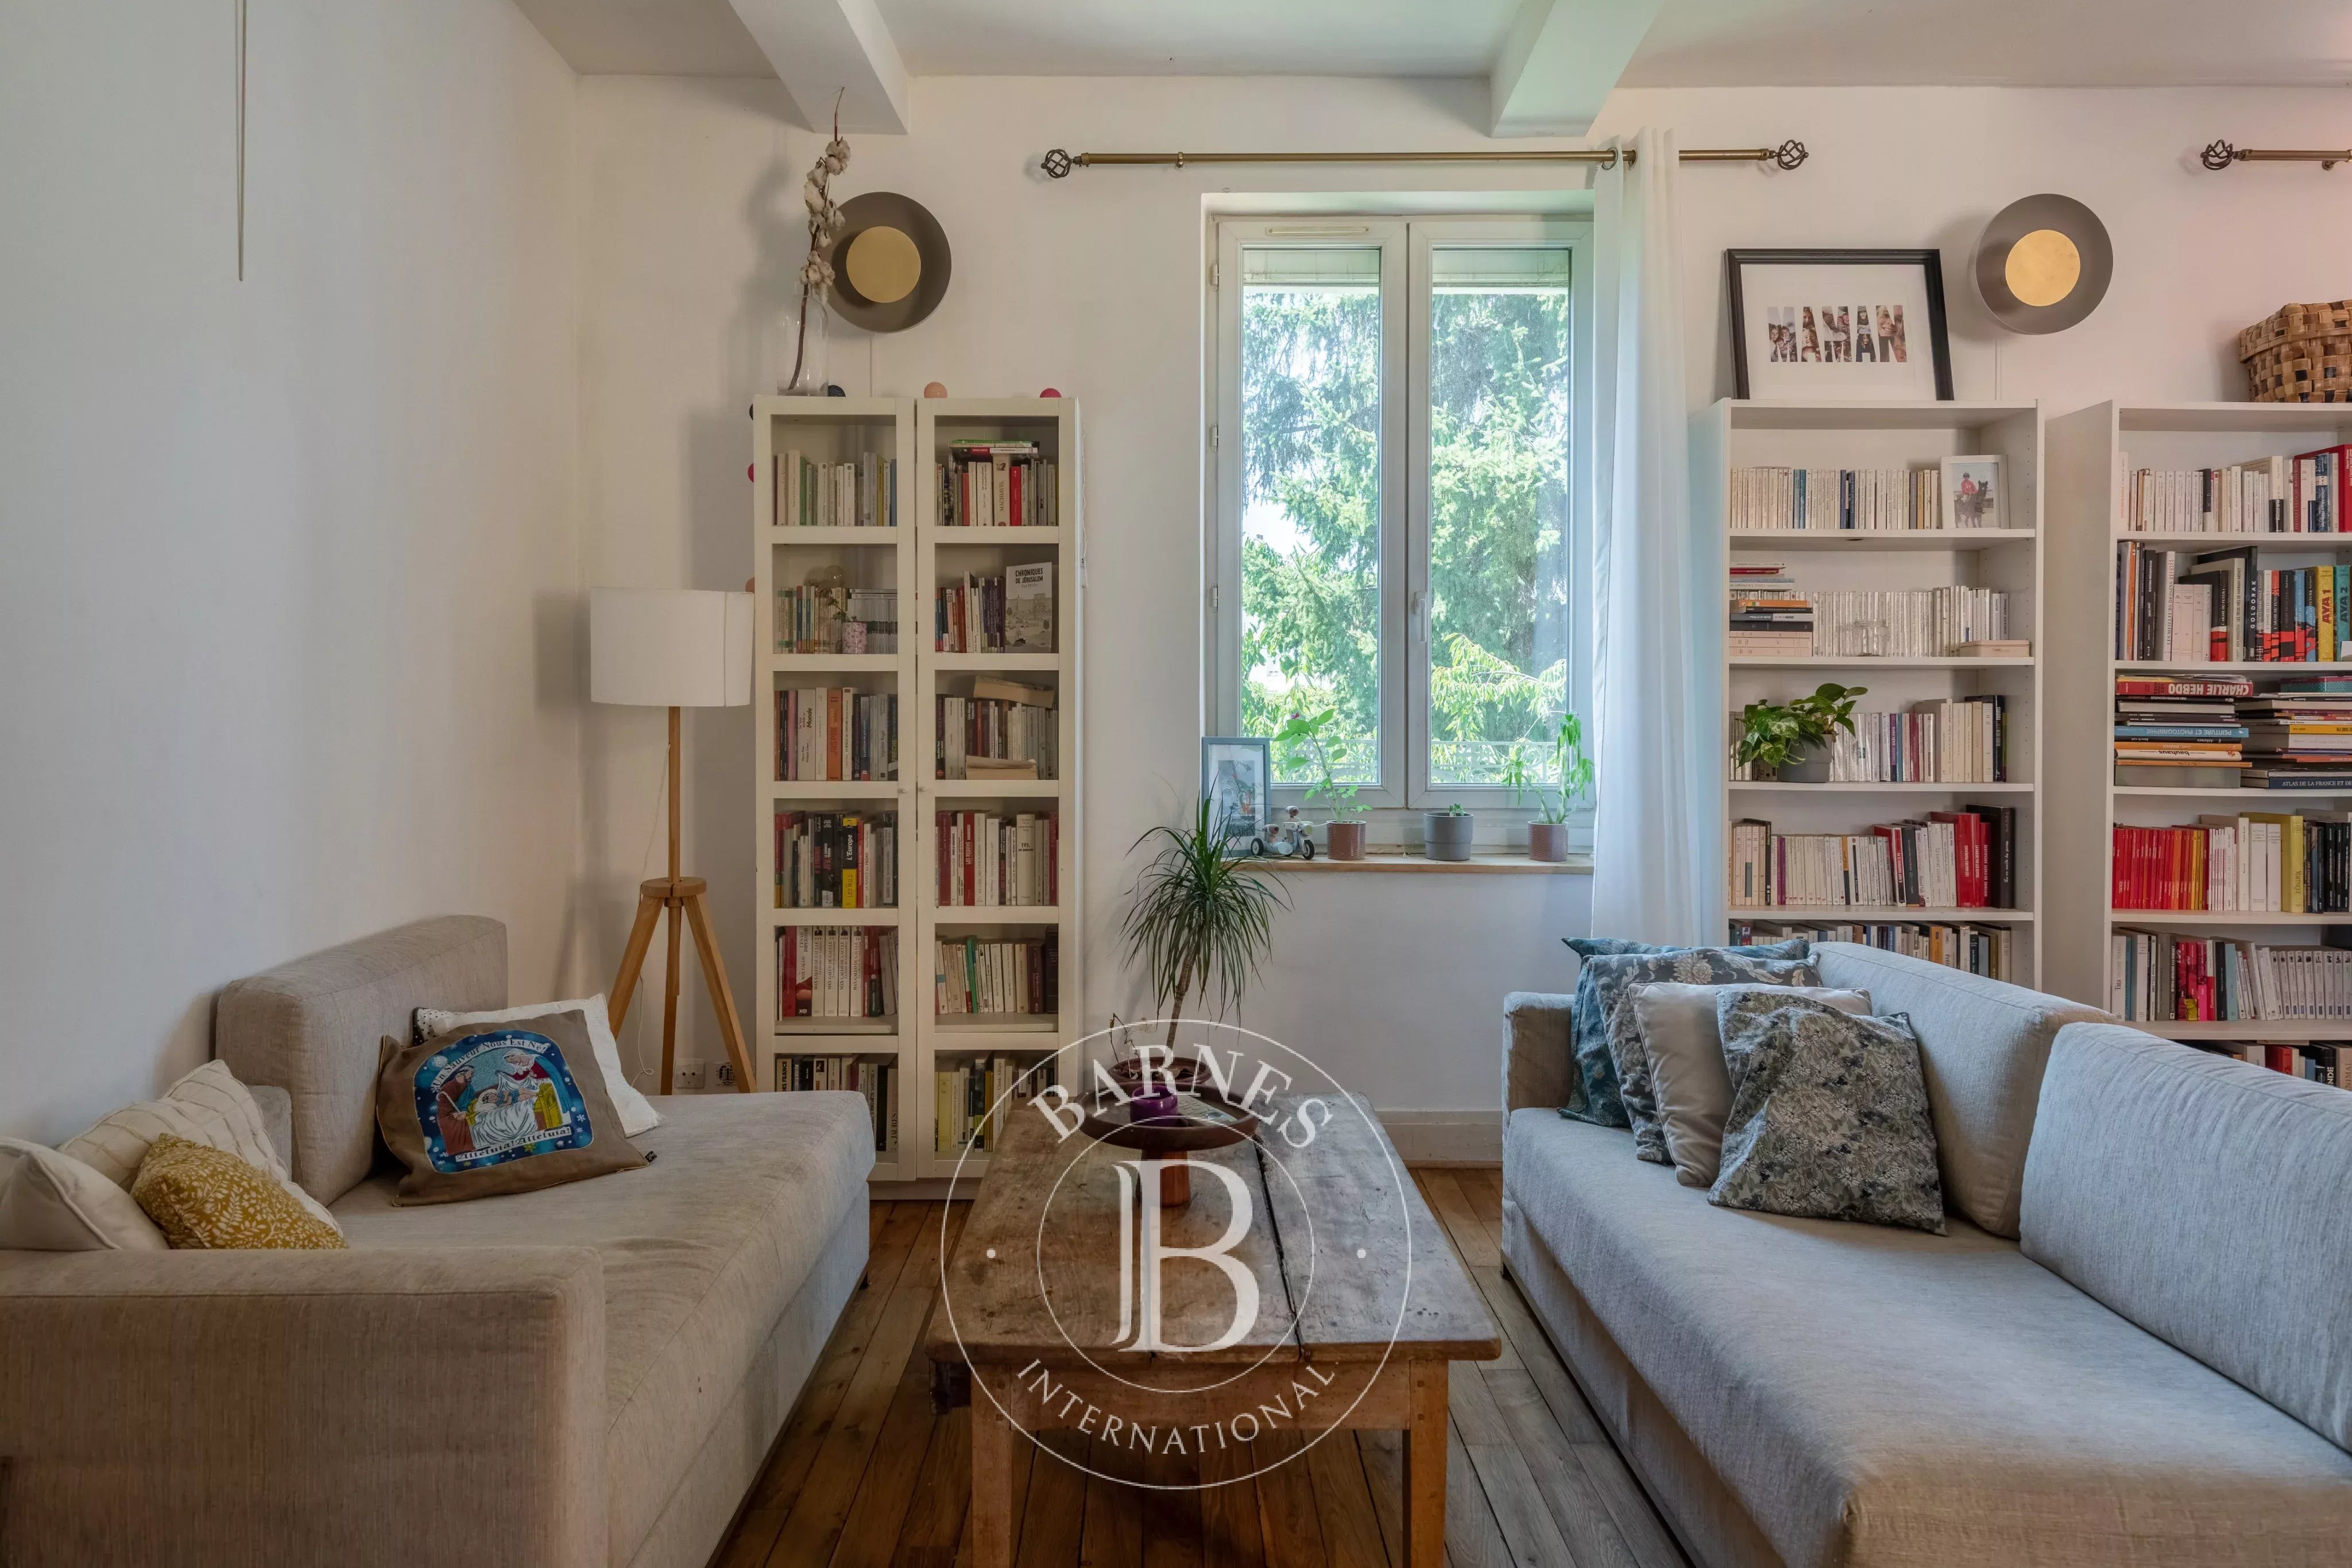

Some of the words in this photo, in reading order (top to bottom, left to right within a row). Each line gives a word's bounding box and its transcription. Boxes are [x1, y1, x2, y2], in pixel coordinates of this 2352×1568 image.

[1767, 305, 1908, 363] MAMAN
[1015, 567, 1043, 577] CHRONIQUES
[1022, 575, 1043, 583] JÉRUSALEM
[2322, 597, 2330, 624] AYA
[2168, 683, 2204, 695] HEBDO
[2207, 684, 2249, 695] CHARLIE
[432, 1074, 446, 1086] Un
[444, 1046, 480, 1073] Sauveur
[482, 1040, 506, 1048] Nous
